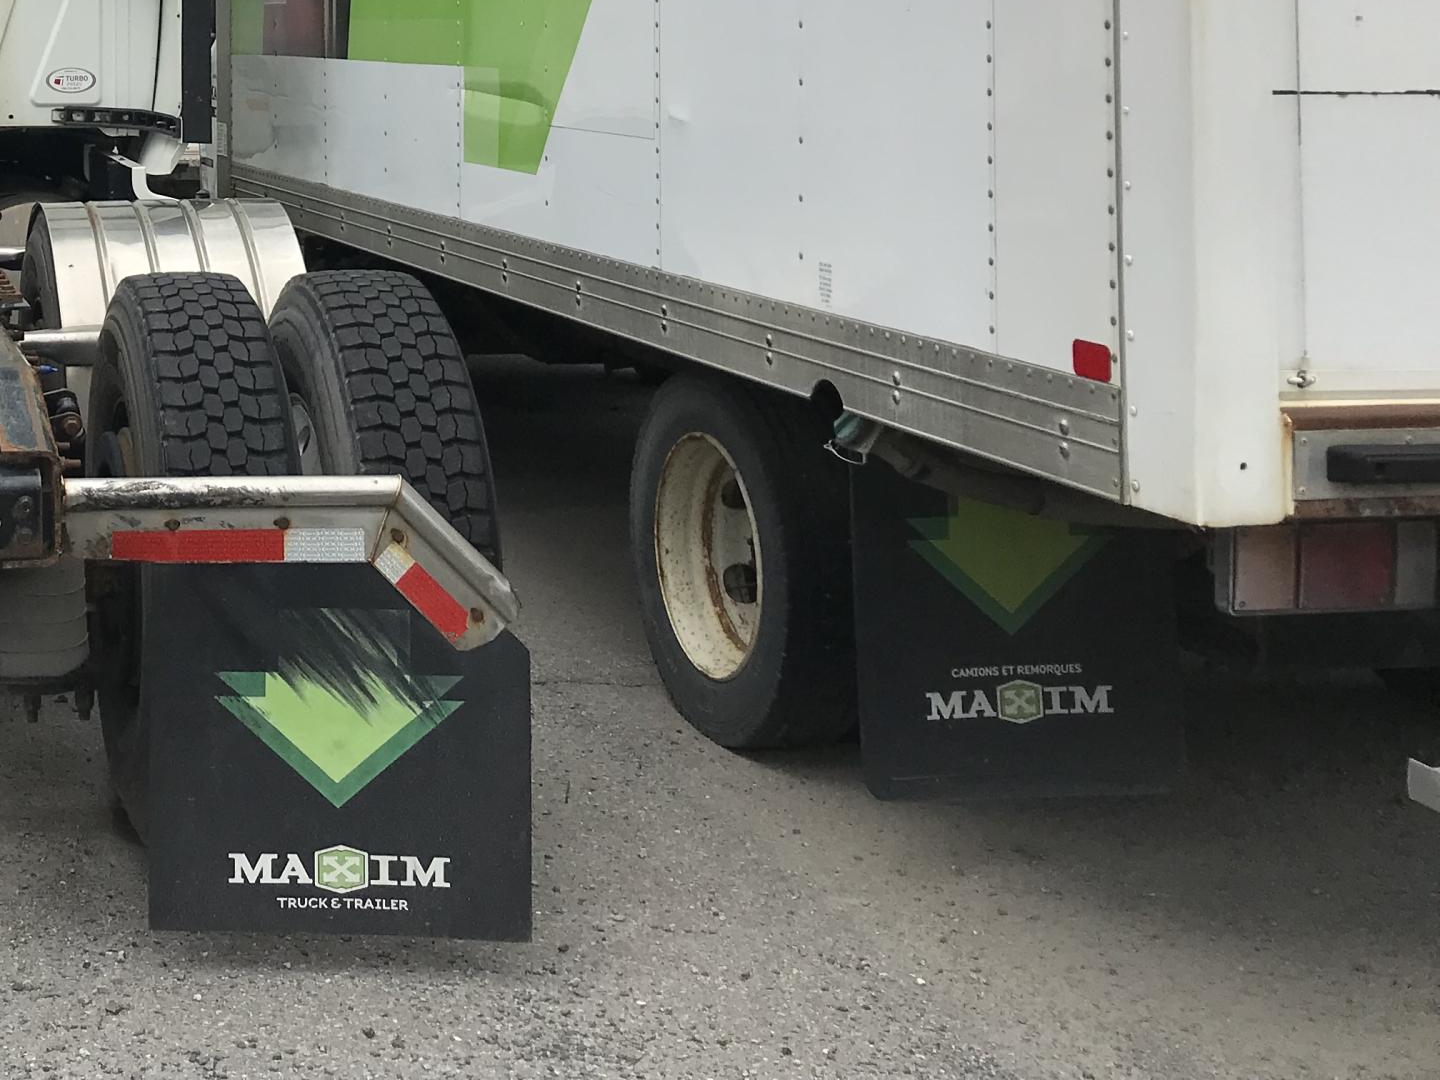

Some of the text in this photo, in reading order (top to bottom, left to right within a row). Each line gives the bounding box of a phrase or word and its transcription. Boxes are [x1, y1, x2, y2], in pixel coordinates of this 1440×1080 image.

[951, 663, 1083, 679] CAMIONS ET REMORQUES
[925, 680, 1115, 723] MAXIM
[228, 845, 451, 893] MAXIM
[276, 897, 409, 911] TRUCK & TRAILER
